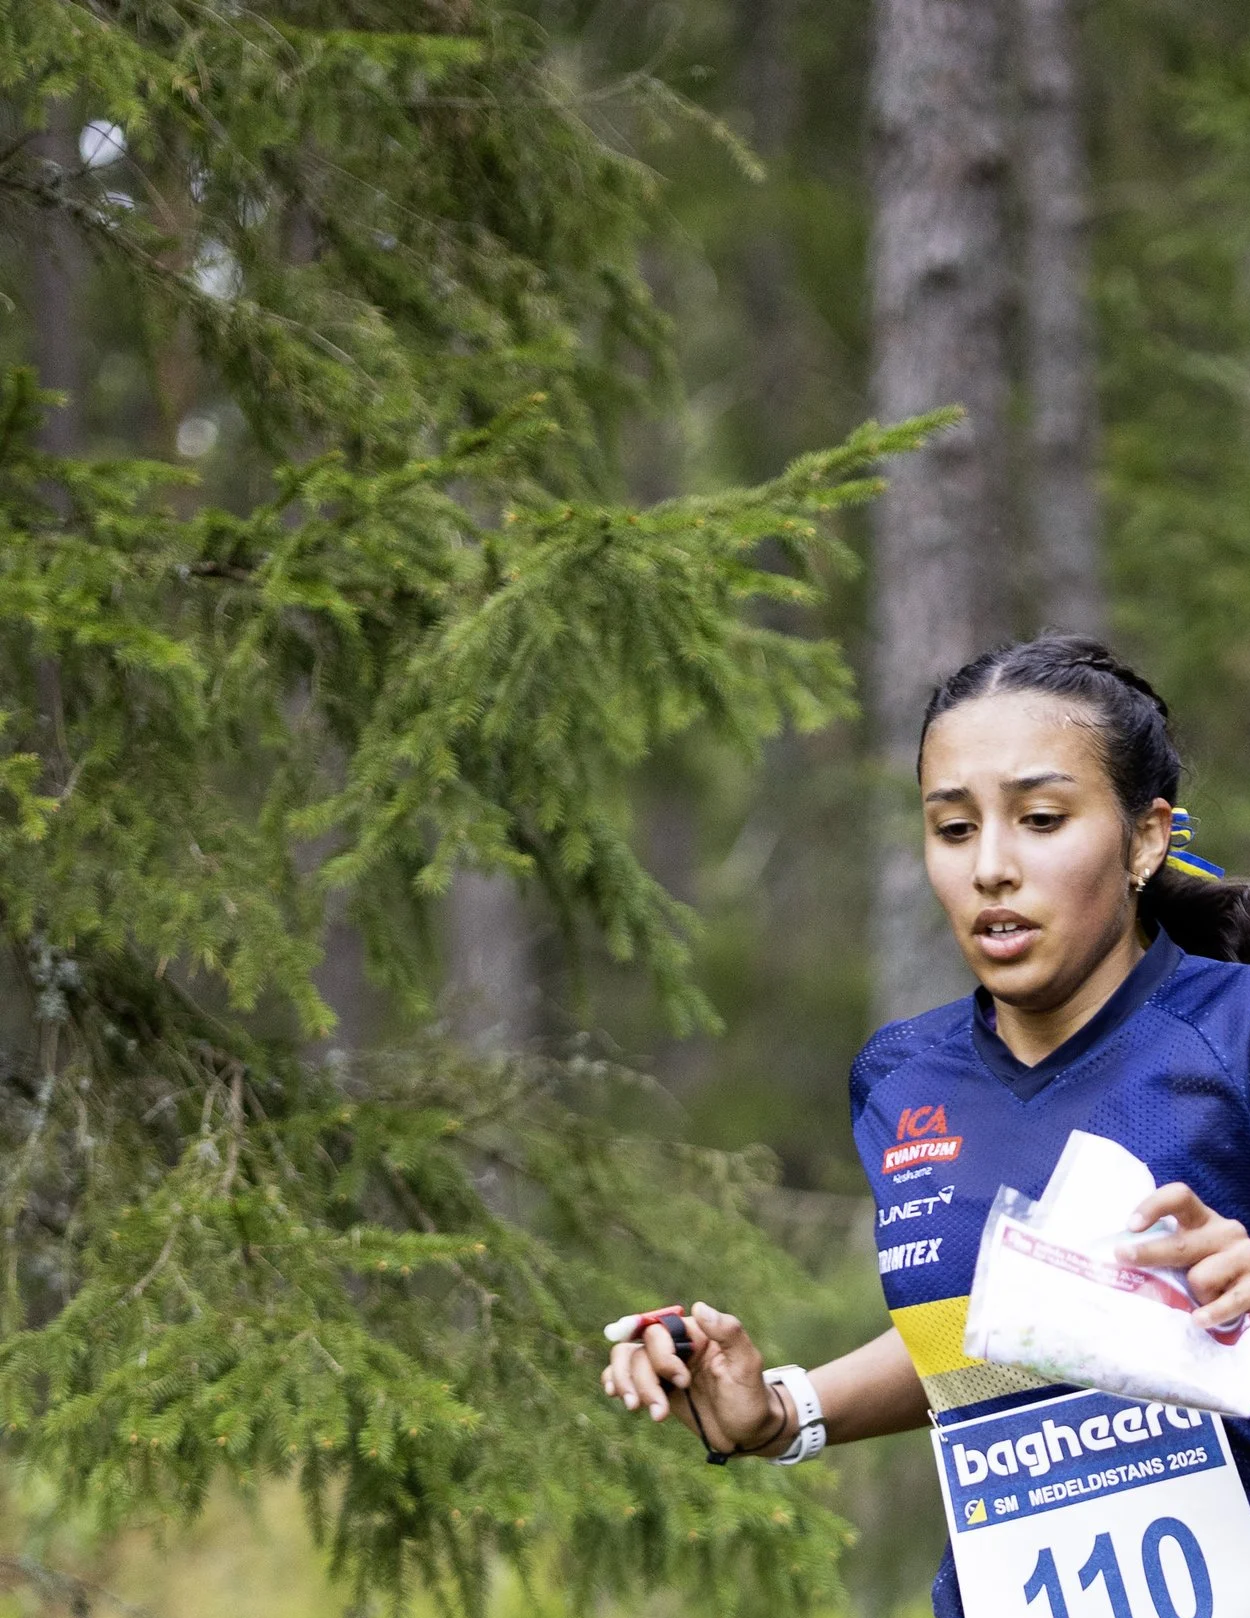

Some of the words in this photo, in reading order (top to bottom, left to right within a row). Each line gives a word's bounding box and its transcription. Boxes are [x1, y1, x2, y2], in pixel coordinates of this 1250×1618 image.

[896, 1104, 947, 1140] ICA
[885, 1141, 957, 1169] KVANTUM
[878, 1196, 941, 1228] UNET
[878, 1237, 943, 1275] RIMTEX
[952, 1403, 1203, 1487] bagheera
[993, 1494, 1019, 1515] SM
[1029, 1457, 1166, 1507] MEDELDISTANS
[1167, 1446, 1208, 1470] 2025
